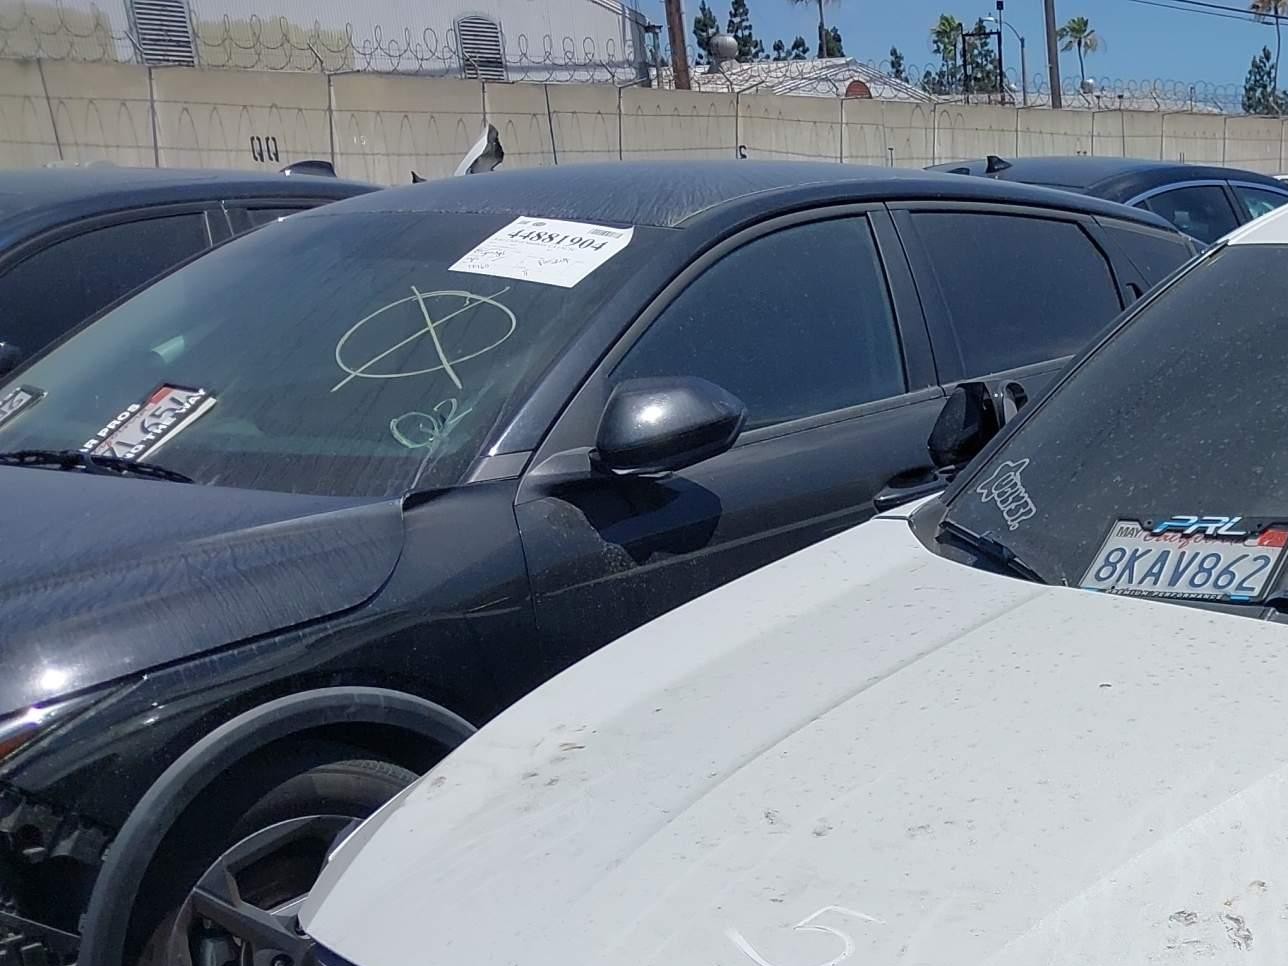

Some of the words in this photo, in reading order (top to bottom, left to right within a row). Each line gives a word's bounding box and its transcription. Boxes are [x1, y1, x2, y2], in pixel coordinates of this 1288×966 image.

[508, 229, 608, 252] 44881904
[97, 403, 140, 437] PROS
[144, 417, 177, 441] THE
[175, 388, 206, 413] WAY
[1116, 526, 1144, 538] MAY
[1151, 515, 1248, 536] PRL
[1094, 547, 1272, 593] 8KAV862
[1105, 587, 1149, 598] PREMIUM
[1152, 589, 1225, 601] PERFORMANCE
